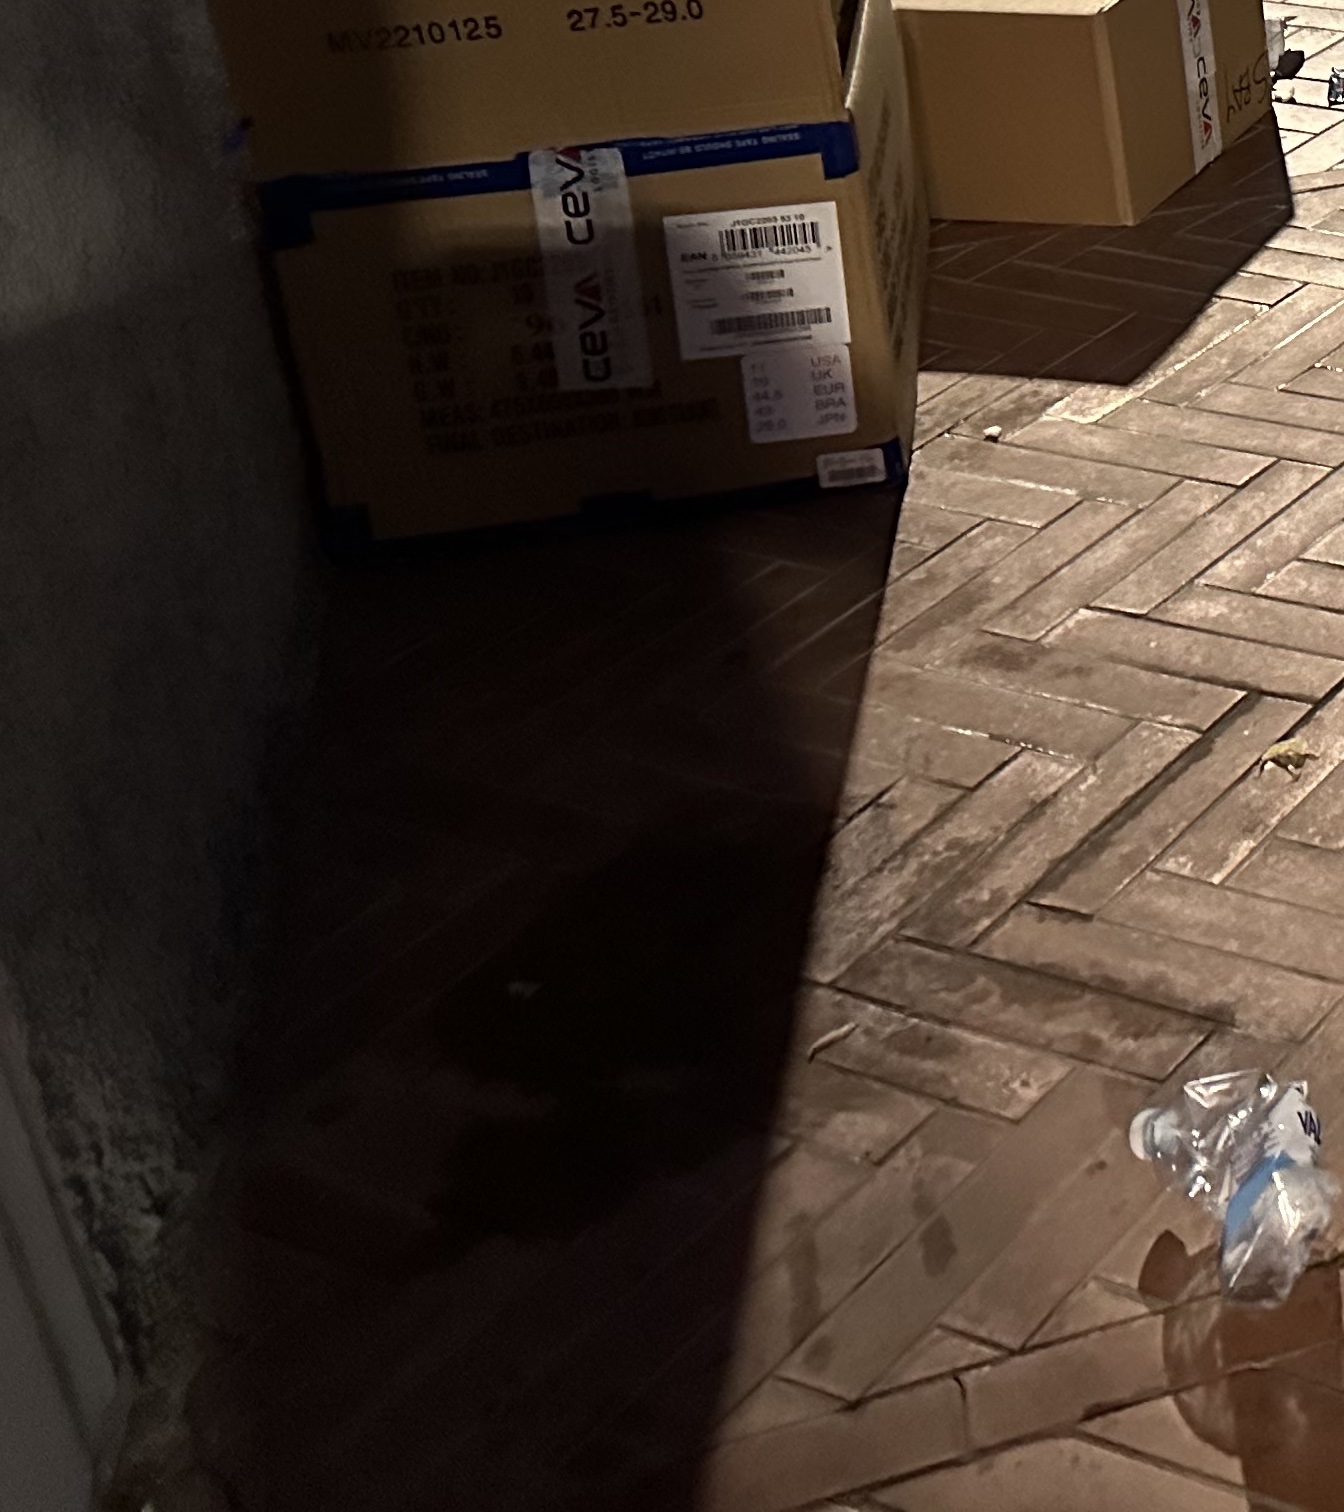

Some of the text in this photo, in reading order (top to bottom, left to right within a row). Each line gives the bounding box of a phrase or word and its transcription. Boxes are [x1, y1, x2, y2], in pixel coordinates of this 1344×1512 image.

[327, 15, 503, 55] MV2210125
[810, 354, 842, 368] USA
[811, 369, 833, 381] UK
[813, 382, 846, 397] EUR
[815, 396, 848, 411] BRA
